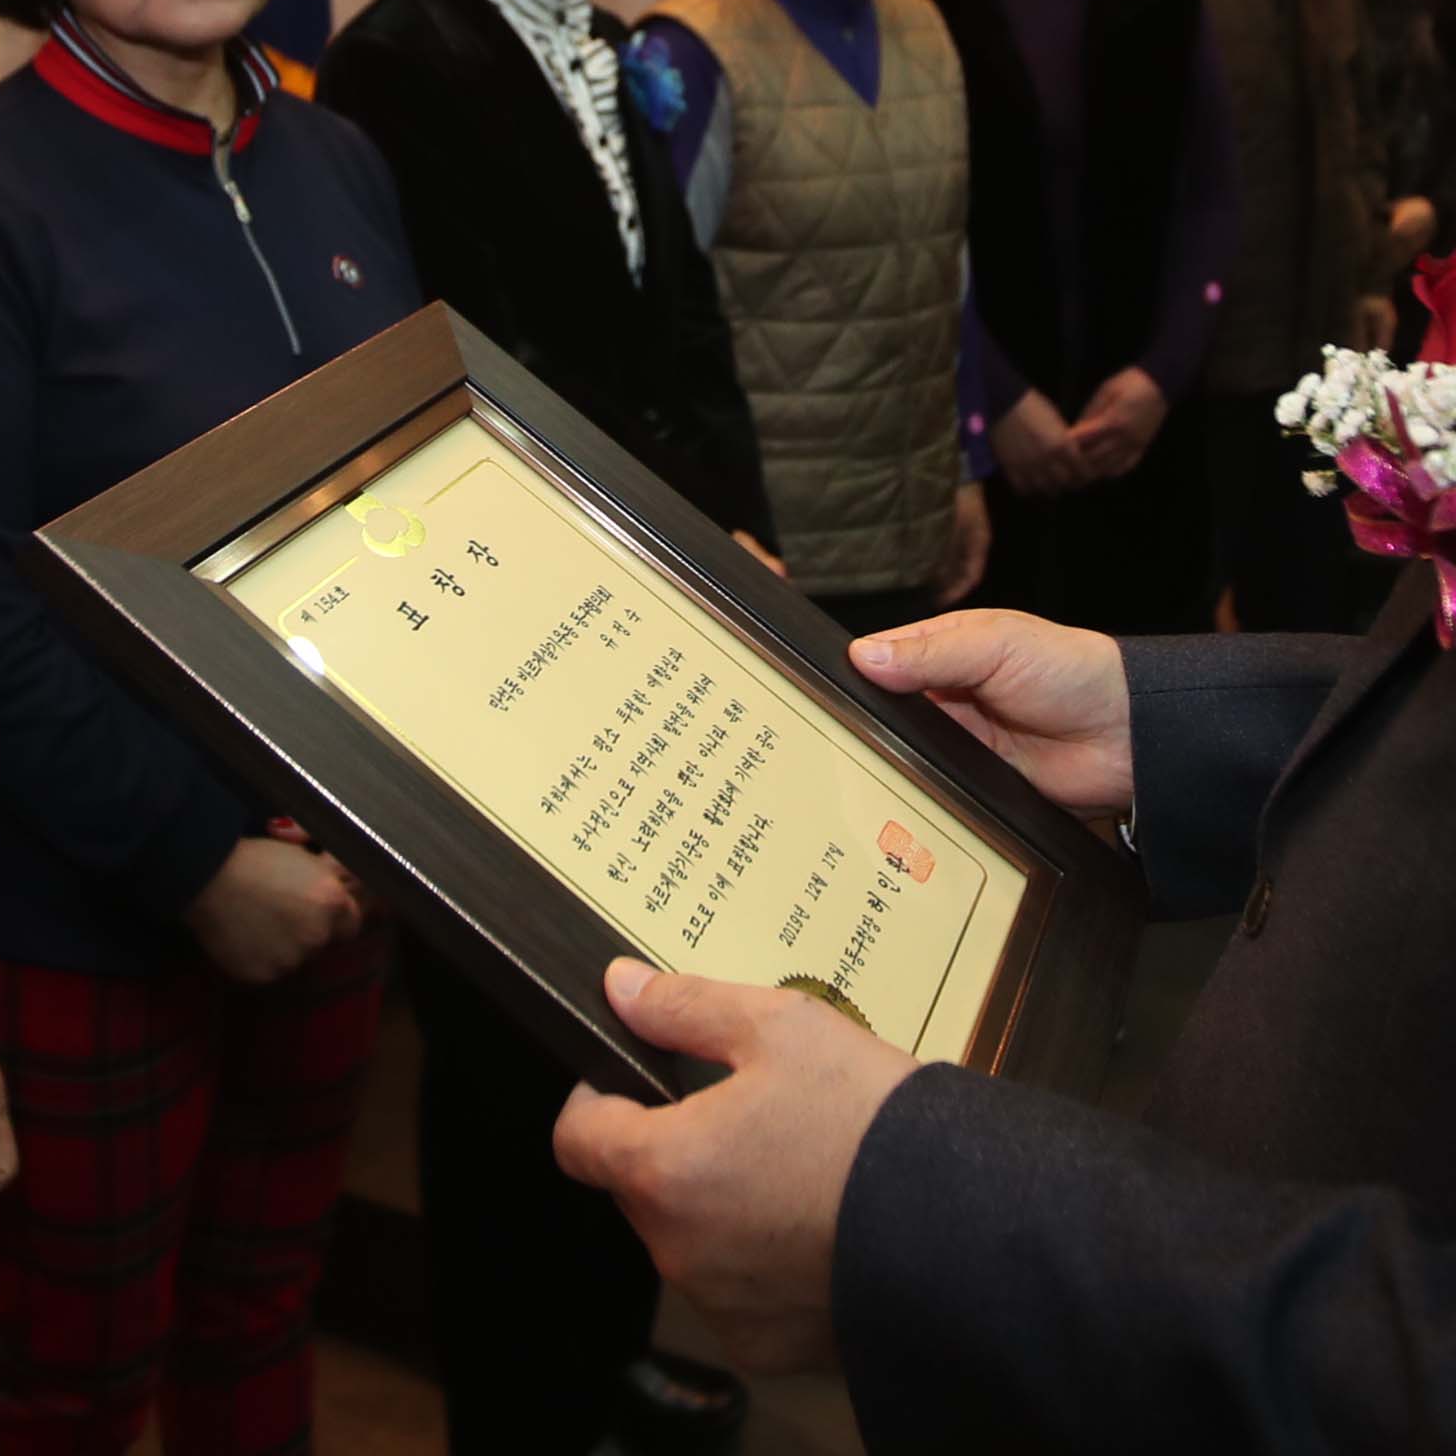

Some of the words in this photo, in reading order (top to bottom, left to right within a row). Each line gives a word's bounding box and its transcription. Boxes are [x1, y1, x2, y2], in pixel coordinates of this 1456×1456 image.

[591, 727, 622, 754] 평소
[570, 776, 637, 853] 봉사정신으로
[776, 903, 811, 953] 2019년
